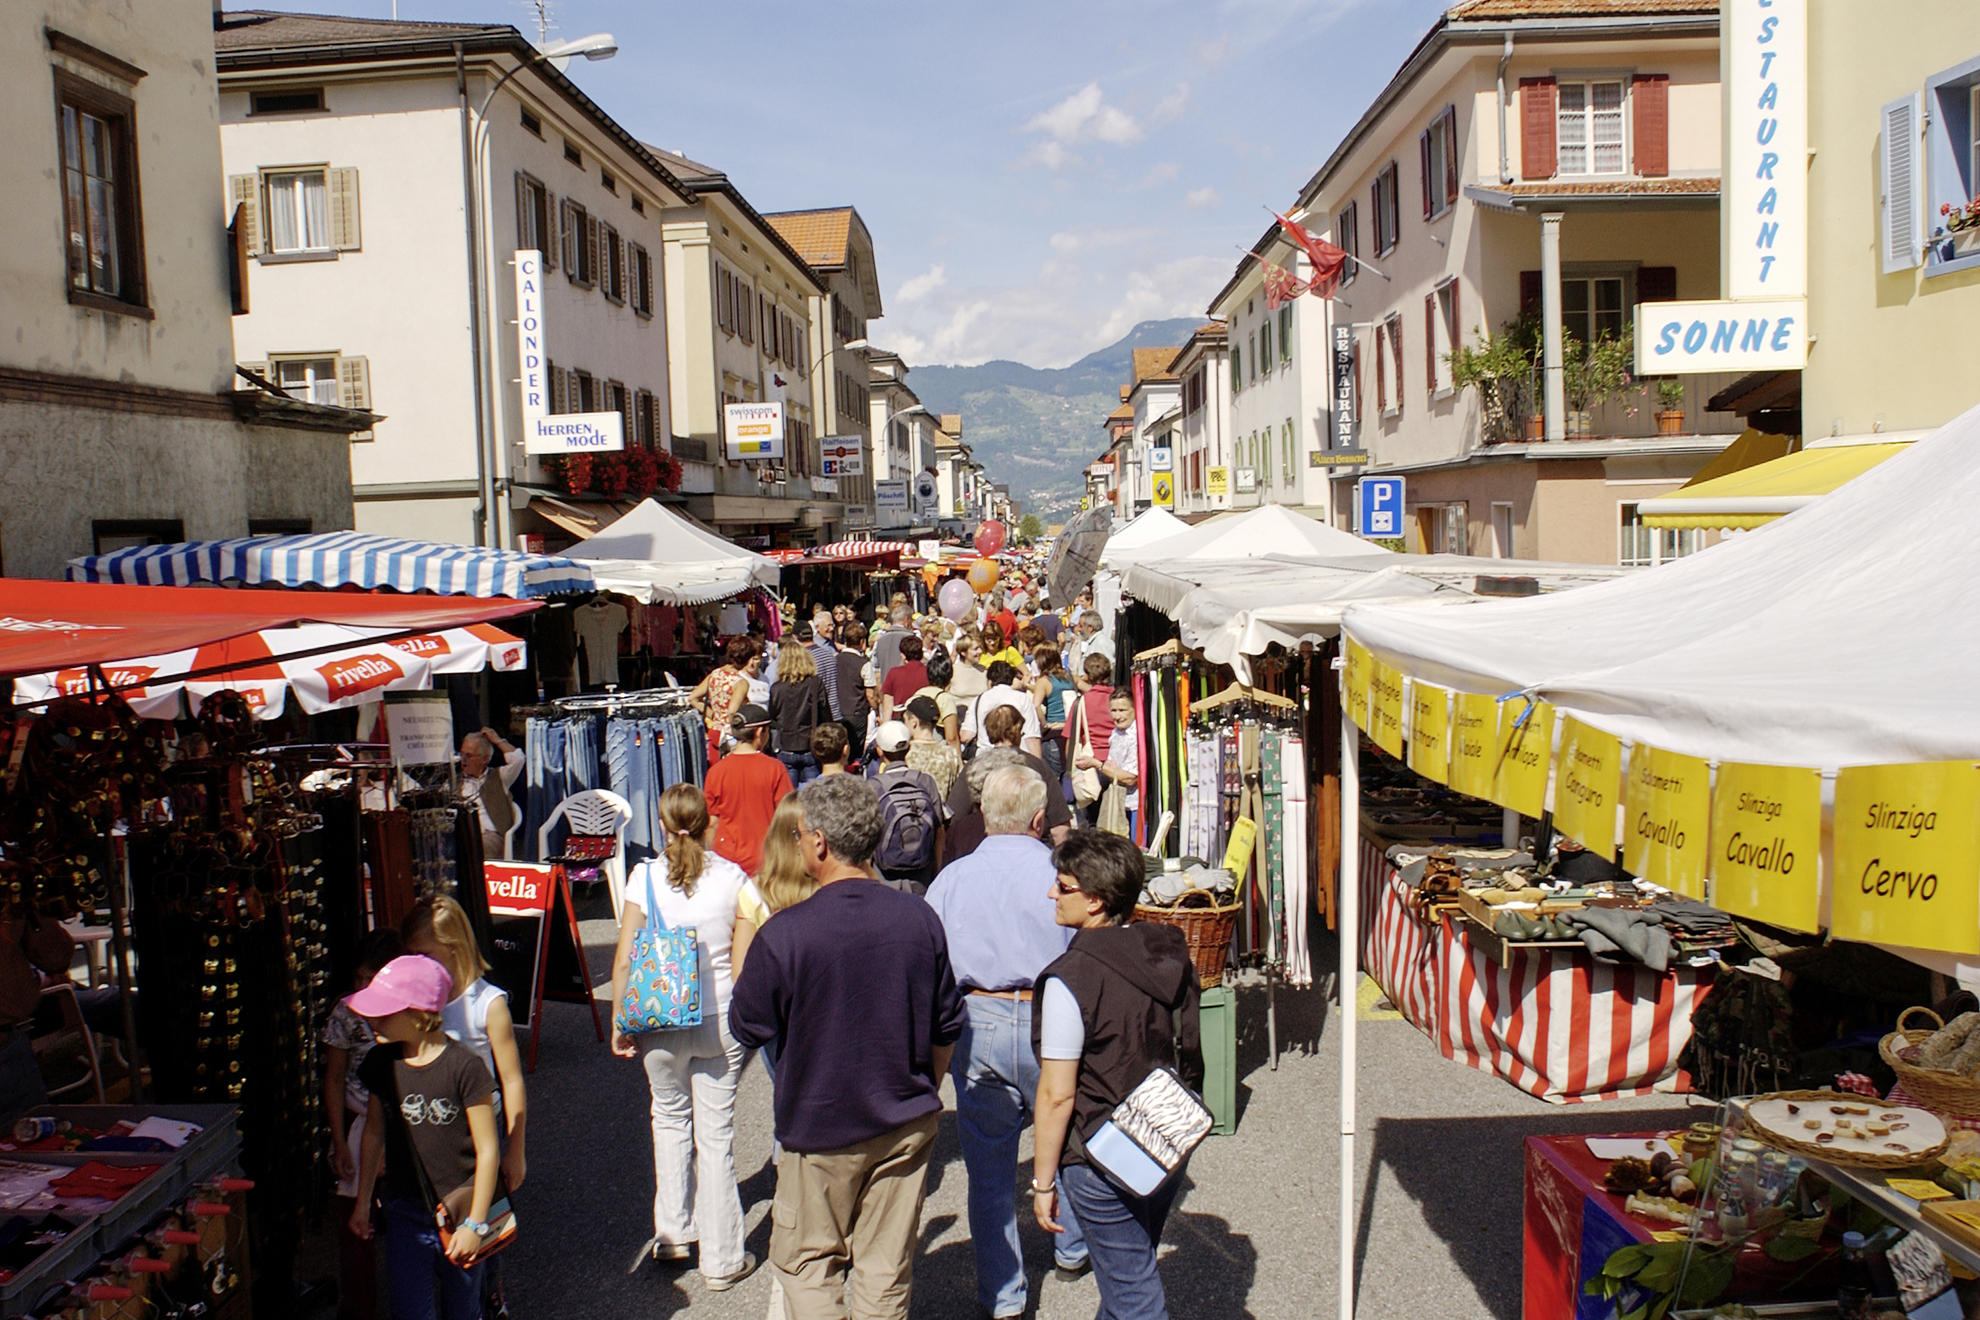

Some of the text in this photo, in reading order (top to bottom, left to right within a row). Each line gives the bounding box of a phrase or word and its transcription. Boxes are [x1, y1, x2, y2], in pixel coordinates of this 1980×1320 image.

[522, 261, 540, 406] CALONDER
[1654, 317, 1795, 355] SONNE
[1336, 327, 1352, 447] RESTAURANT
[730, 406, 773, 416] swisscom
[739, 425, 769, 435] orange
[822, 438, 859, 446] Raiffeisen
[1374, 483, 1392, 511] P
[65, 672, 138, 695] rilla
[332, 658, 393, 688] rivella
[1566, 771, 1603, 807] Canguro
[1641, 767, 1684, 794] Salametti
[1737, 792, 1783, 822] Slinziga
[1865, 801, 1938, 838] Slinziga
[1637, 811, 1685, 849] Cavallo
[1726, 832, 1794, 875] Cavallo
[486, 875, 537, 899] vella
[1861, 858, 1938, 901] Cervo
